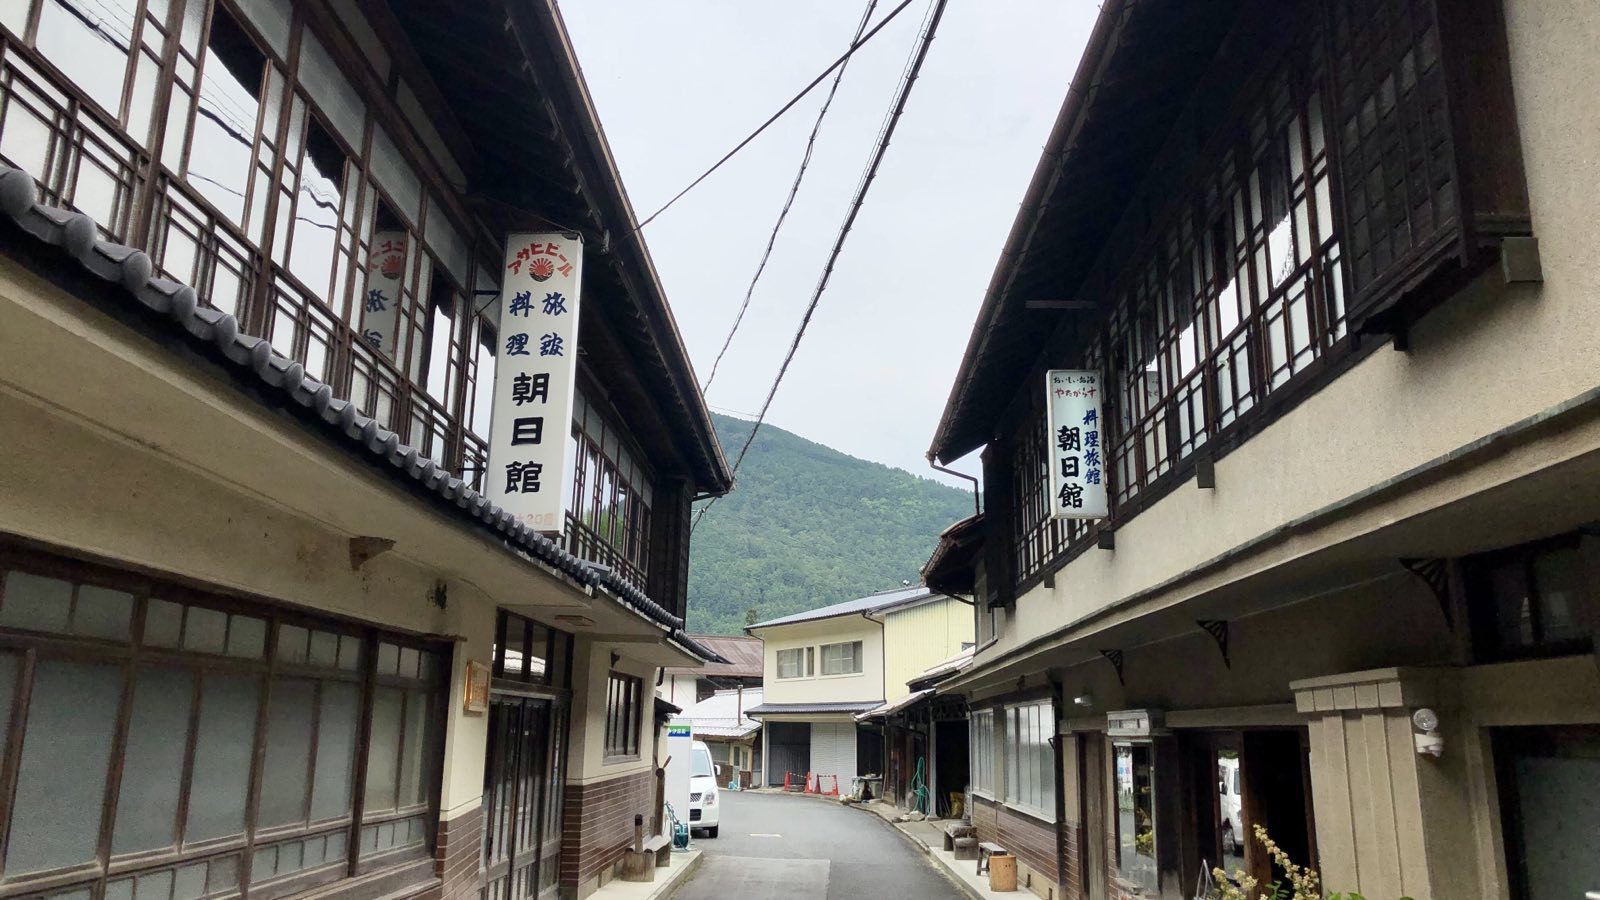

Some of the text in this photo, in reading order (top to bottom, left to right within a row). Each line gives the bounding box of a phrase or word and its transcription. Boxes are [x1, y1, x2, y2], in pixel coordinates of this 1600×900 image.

[507, 242, 574, 278] アサヒビール
[505, 290, 535, 357] 料理
[504, 372, 550, 495] 朝日館
[1057, 425, 1084, 509] 朝日館
[1082, 407, 1101, 485] 料理旅館
